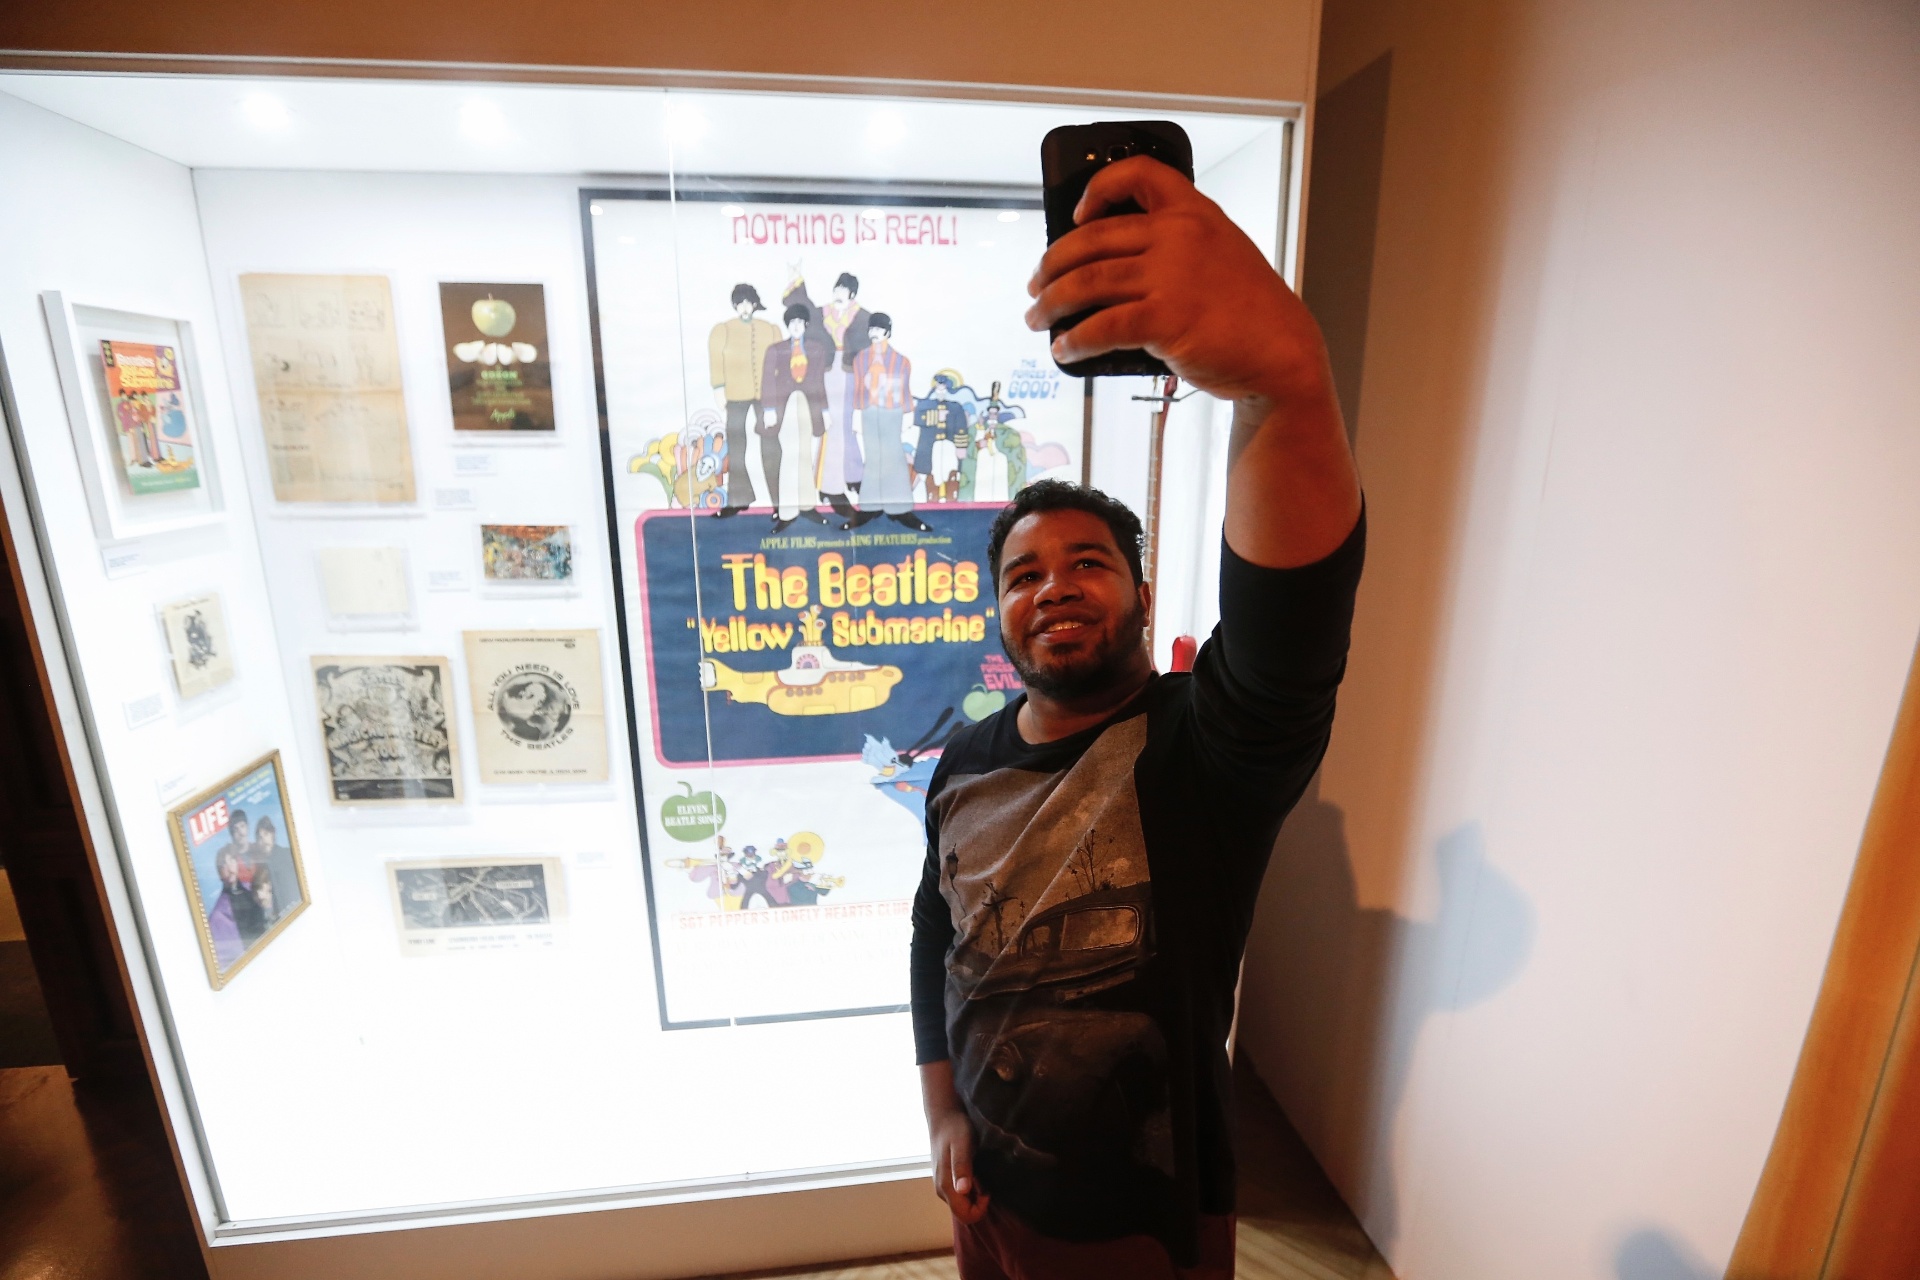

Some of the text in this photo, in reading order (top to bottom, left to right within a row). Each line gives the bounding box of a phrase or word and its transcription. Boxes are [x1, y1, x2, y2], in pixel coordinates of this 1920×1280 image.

[732, 213, 958, 245] NOTHING IS REAL!
[1008, 380, 1060, 399] GOOD!
[760, 537, 788, 549] APPLE
[790, 536, 817, 549] FILMS
[850, 534, 872, 547] KING
[873, 533, 918, 546] FEATURES
[917, 536, 952, 545] production
[721, 549, 979, 611] The Beatles
[487, 663, 580, 711] ALL YOU NEED IS LOVE
[983, 673, 1023, 690] EVIL
[500, 727, 574, 751] THE BEATLES
[189, 799, 229, 842] LIFE
[664, 813, 723, 827] BEATLE SONS
[677, 804, 708, 815] ELEVEN
[679, 916, 704, 930] SGT
[774, 907, 820, 923] LONELY
[824, 904, 873, 919] HEARTS
[878, 901, 910, 917] CLUB
